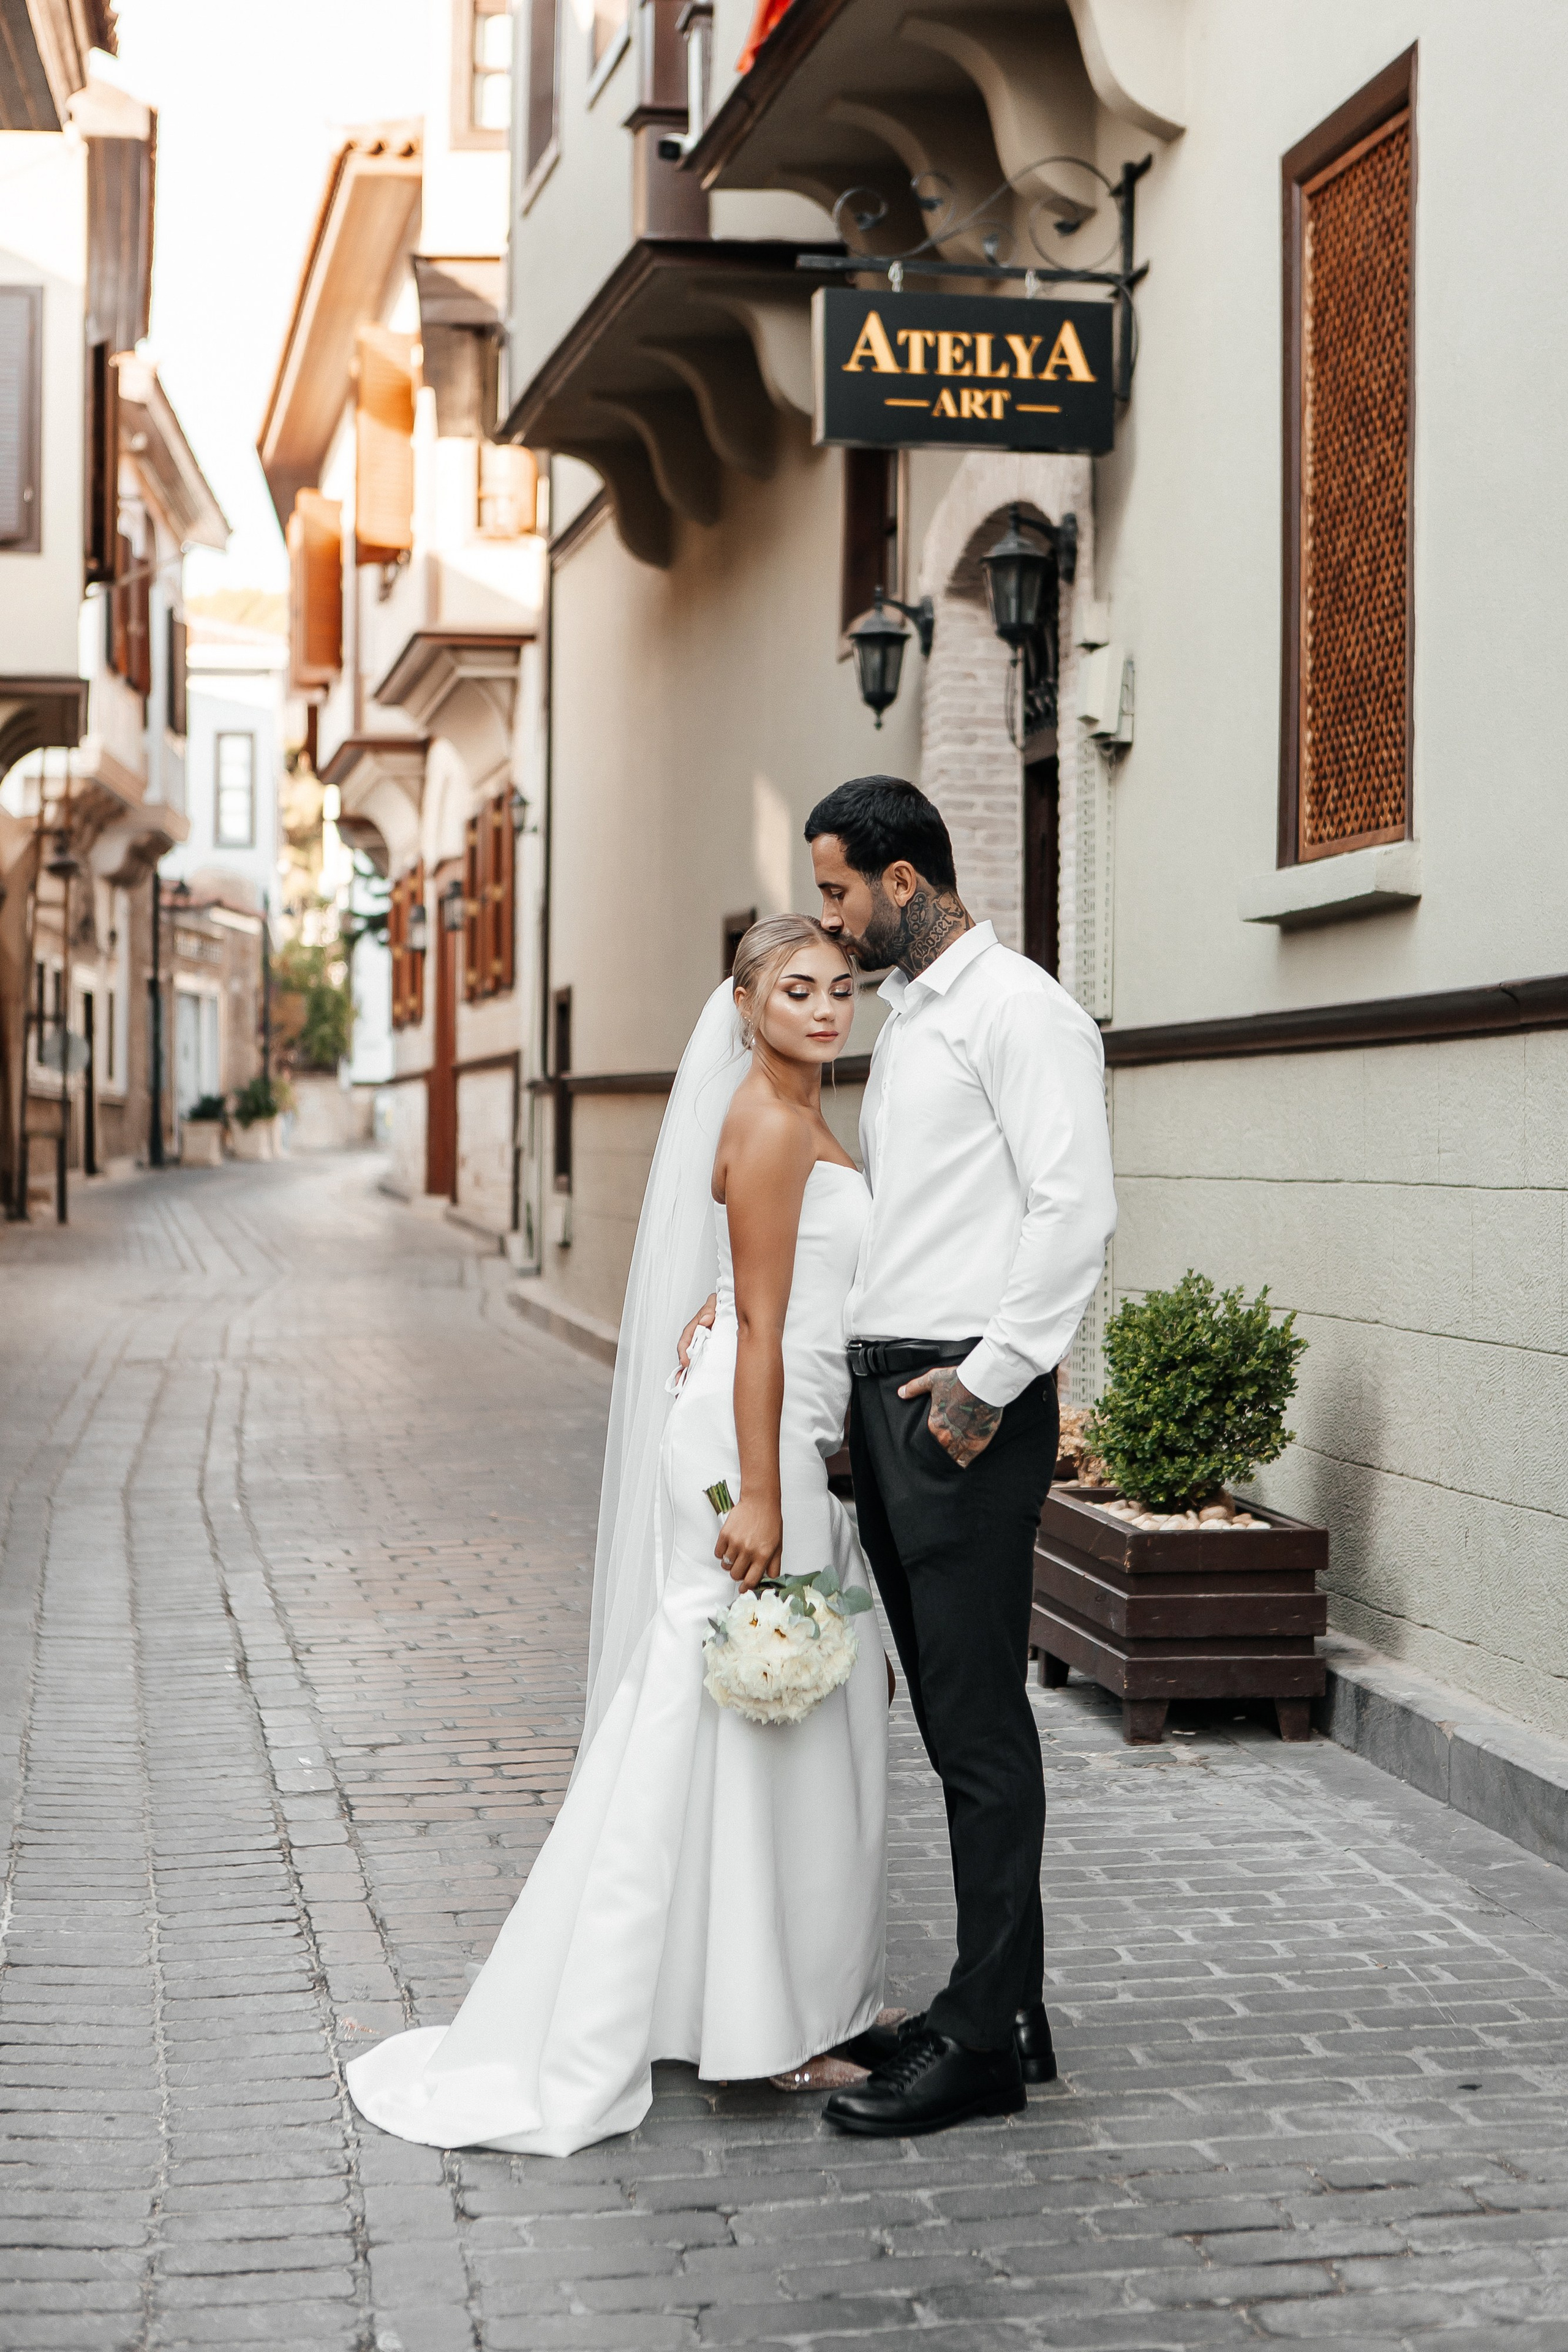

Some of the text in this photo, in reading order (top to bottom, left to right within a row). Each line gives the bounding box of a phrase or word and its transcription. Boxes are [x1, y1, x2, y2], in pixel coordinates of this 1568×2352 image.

[843, 311, 1096, 382] ATELYA
[933, 388, 1010, 420] ART
[912, 914, 952, 957] Boxer
